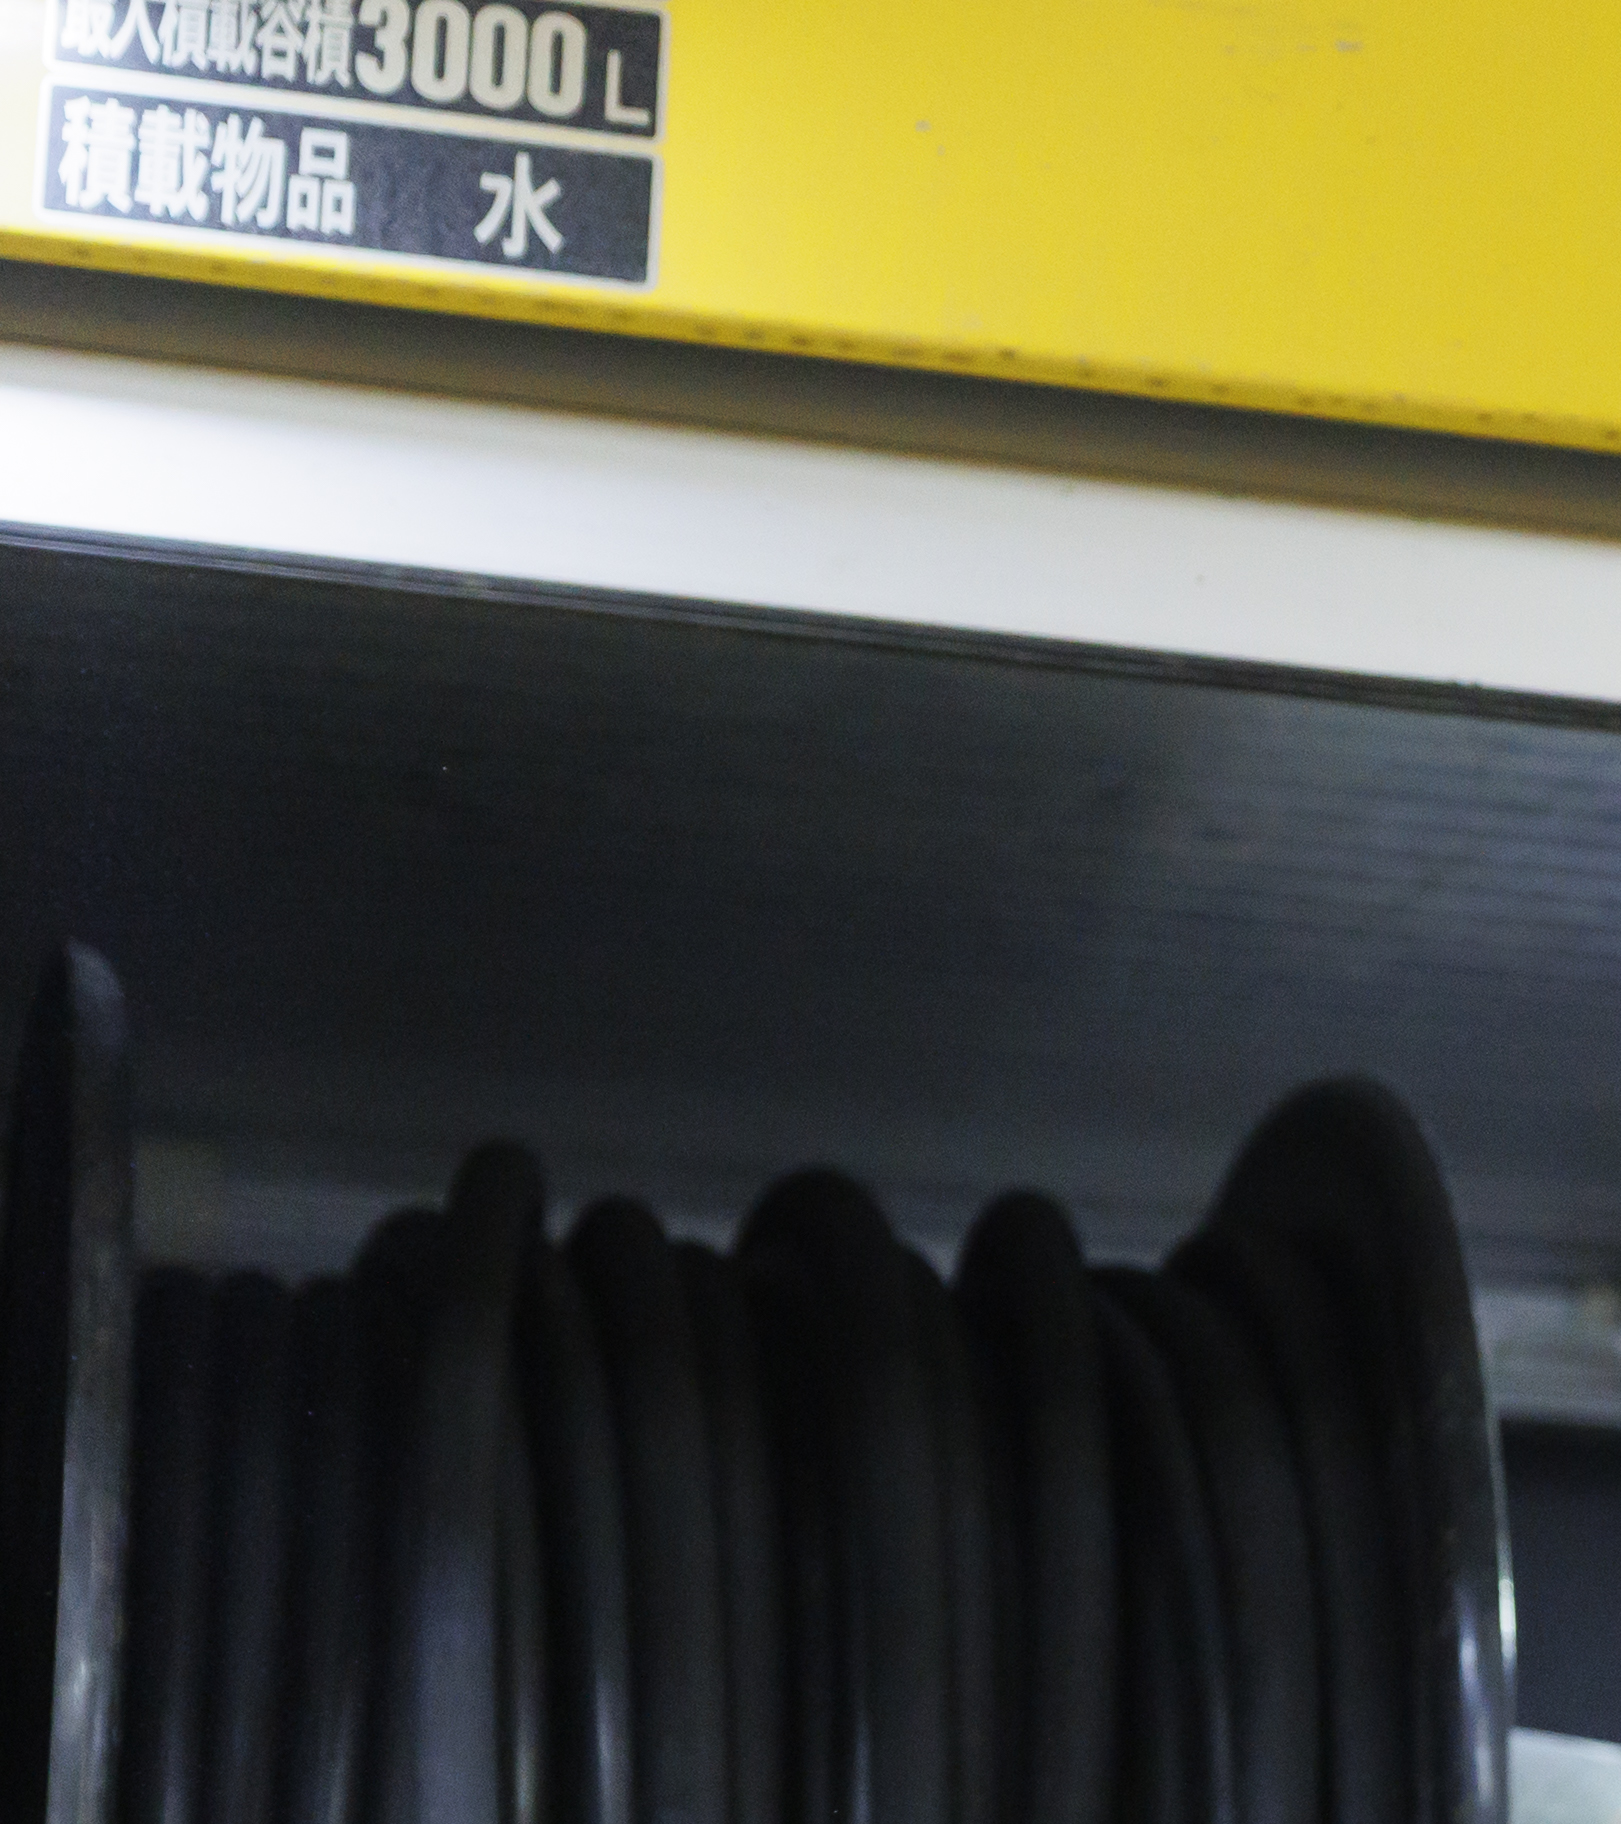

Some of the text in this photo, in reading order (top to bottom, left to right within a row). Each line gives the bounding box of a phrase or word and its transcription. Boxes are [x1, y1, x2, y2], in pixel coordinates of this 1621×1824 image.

[57, 95, 564, 257] 積載物品 水
